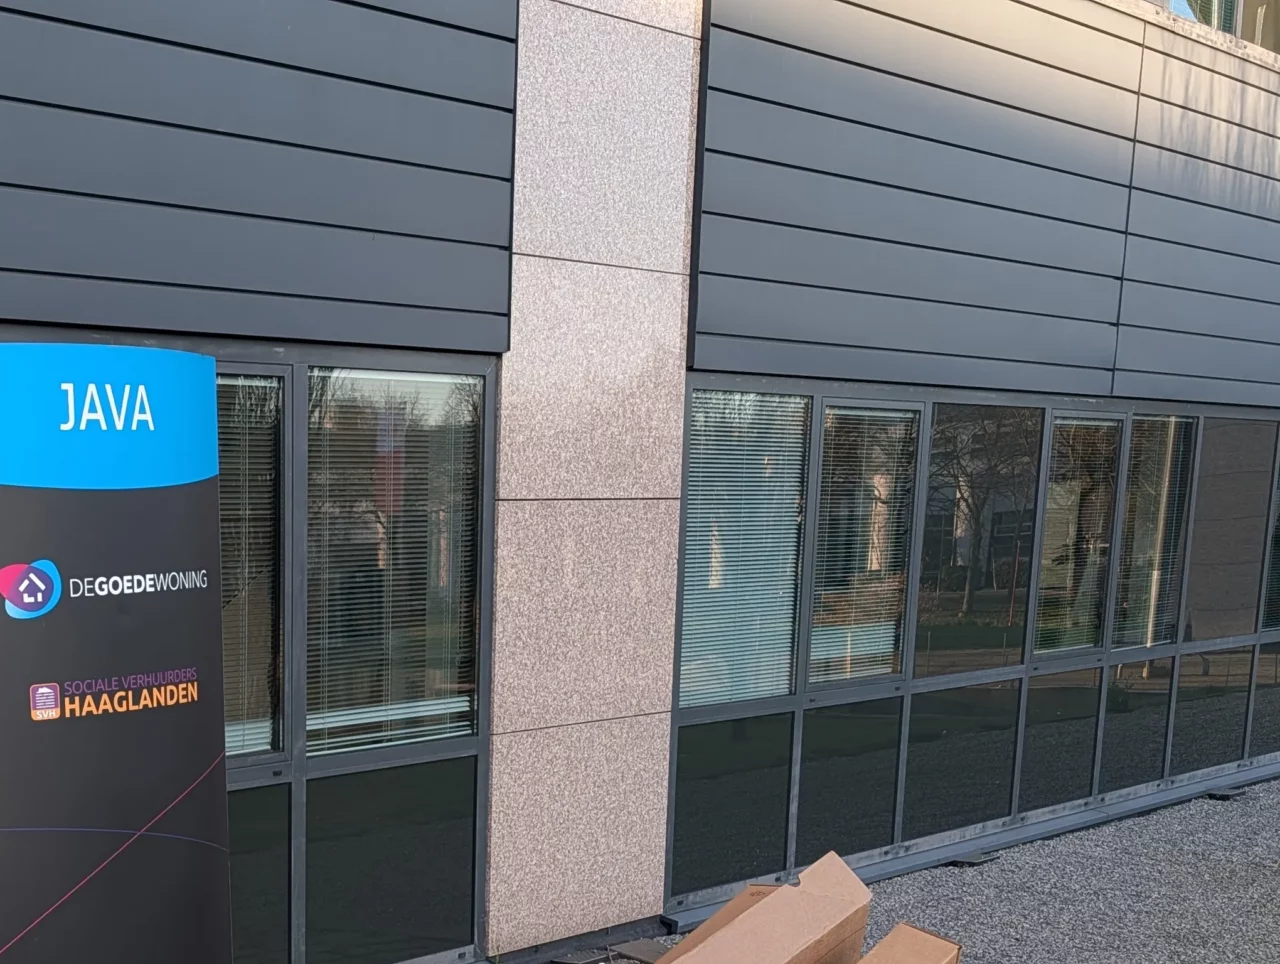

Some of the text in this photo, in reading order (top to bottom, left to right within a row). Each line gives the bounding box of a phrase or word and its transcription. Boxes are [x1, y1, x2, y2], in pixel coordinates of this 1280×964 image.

[59, 382, 155, 431] JAVA
[69, 569, 208, 598] DEGOEDEWONING
[64, 667, 197, 695] SOCIALE VERHUURDERS
[64, 681, 198, 718] HAAGLANDEN
[36, 710, 56, 719] SVH
